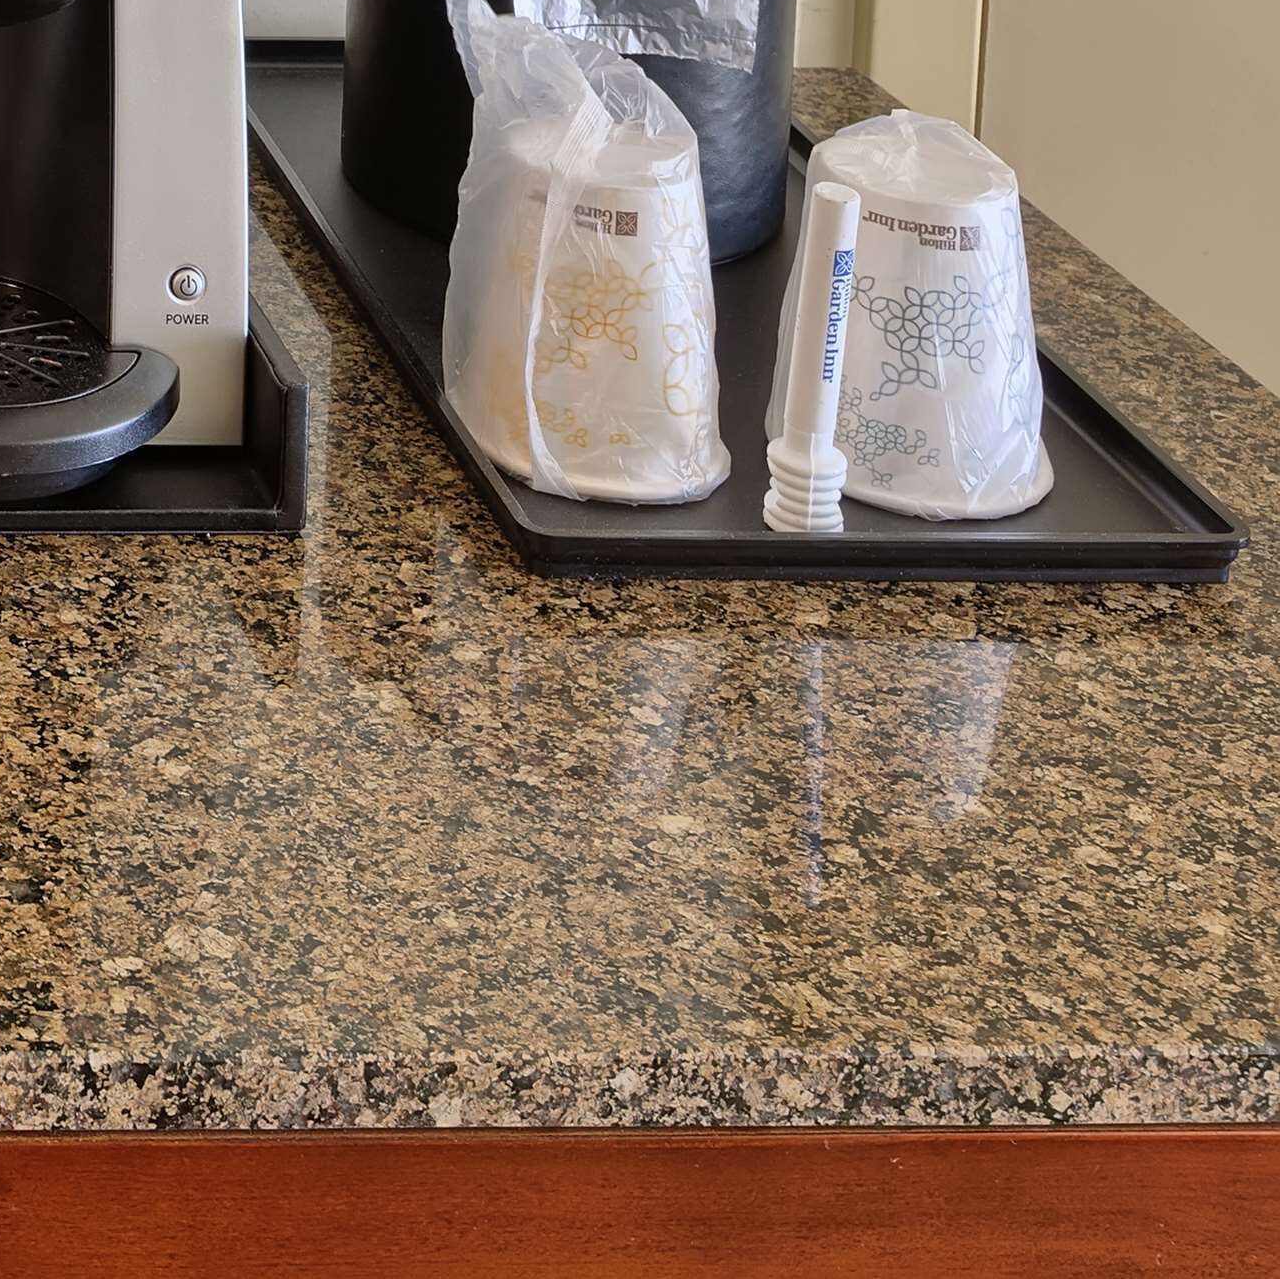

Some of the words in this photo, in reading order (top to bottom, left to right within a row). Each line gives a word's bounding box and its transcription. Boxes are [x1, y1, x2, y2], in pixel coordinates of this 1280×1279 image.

[867, 210, 895, 231] Inn
[897, 219, 957, 240] Garden
[919, 237, 956, 251] Hilton
[166, 314, 209, 325] POWER
[825, 278, 845, 345] Garden
[822, 349, 839, 380] Inn
